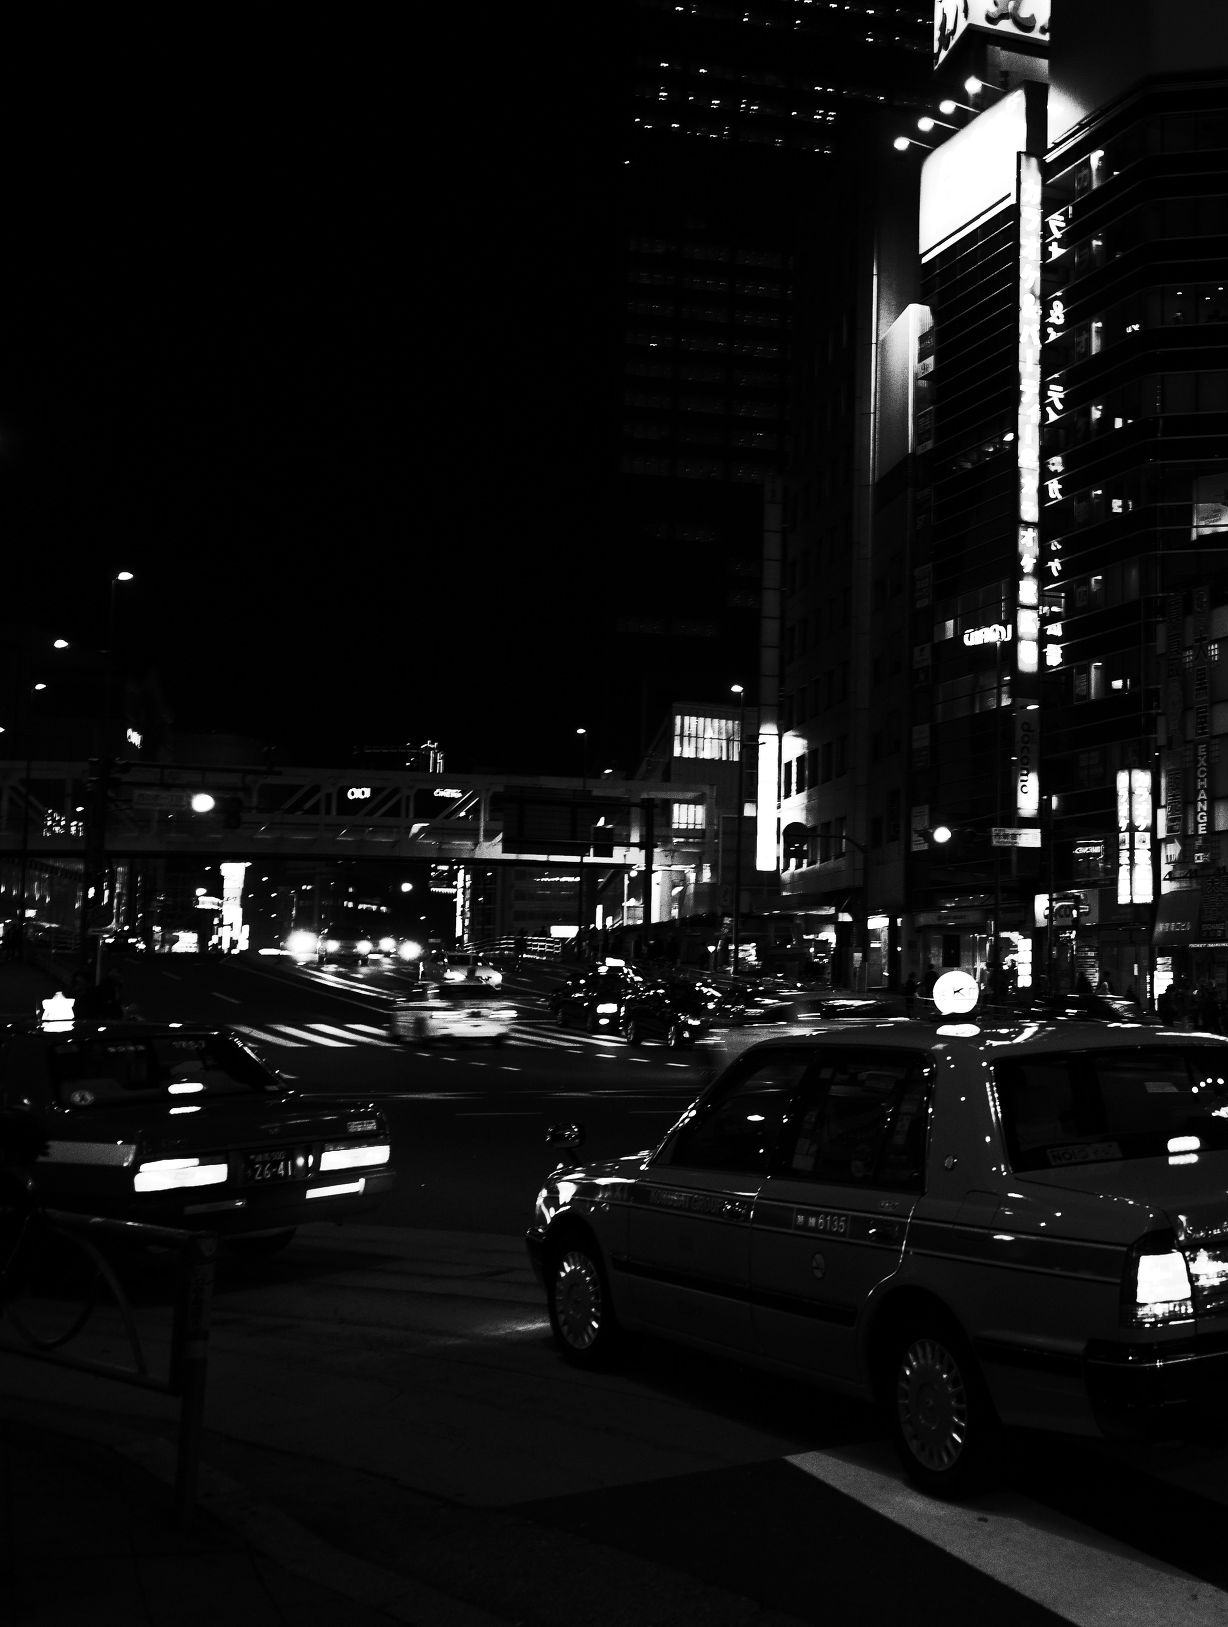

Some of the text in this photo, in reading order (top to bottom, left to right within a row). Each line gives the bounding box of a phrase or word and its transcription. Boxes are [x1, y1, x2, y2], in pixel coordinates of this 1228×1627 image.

[1020, 721, 1034, 795] docomo
[1196, 744, 1208, 835] EXCHANGE
[255, 1160, 293, 1181] 26-41
